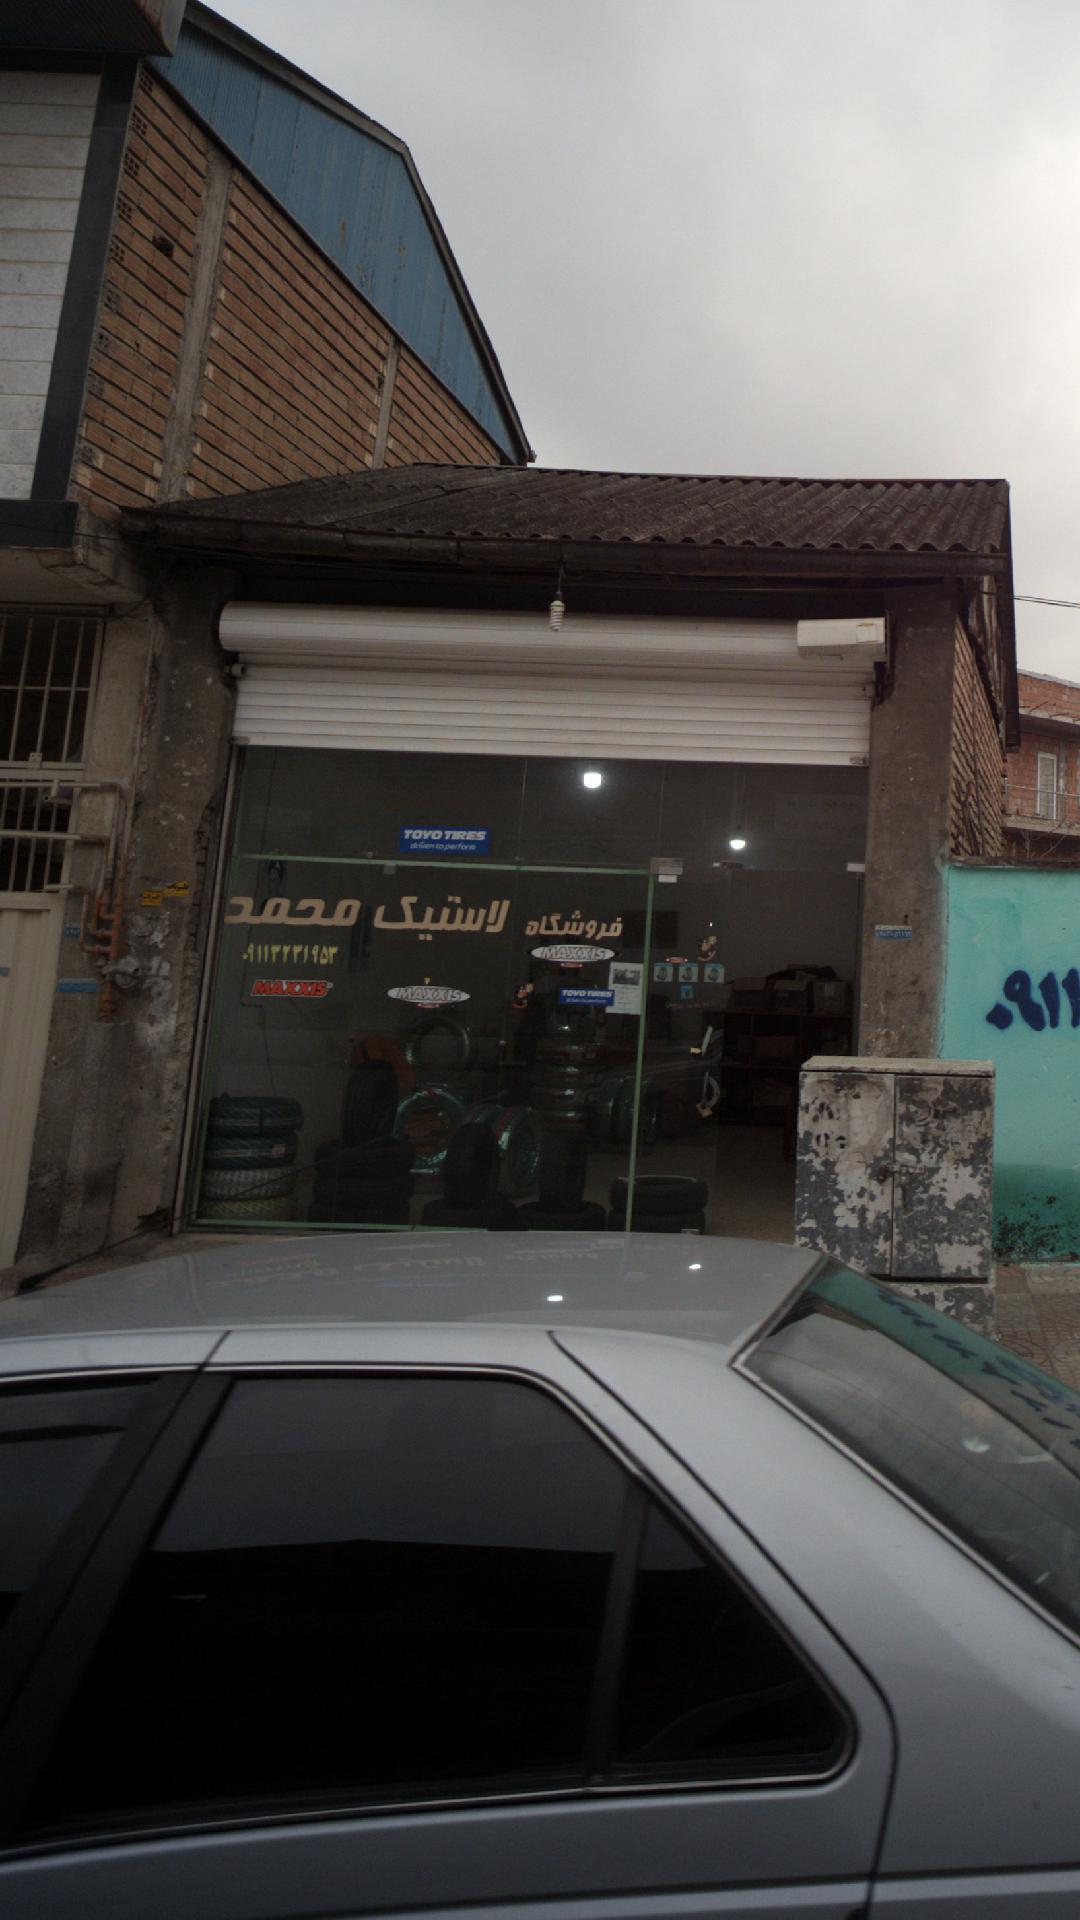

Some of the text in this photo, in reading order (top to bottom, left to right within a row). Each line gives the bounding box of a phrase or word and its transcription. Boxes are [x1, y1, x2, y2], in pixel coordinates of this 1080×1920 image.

[403, 829, 487, 841] TOYO TIRES
[224, 895, 623, 941] فروشگاه لاستیک محمد
[543, 946, 604, 960] MAXXIS
[250, 979, 329, 997] MAXXIS
[399, 987, 459, 1000] MAXXIS
[562, 989, 586, 997] TOYO
